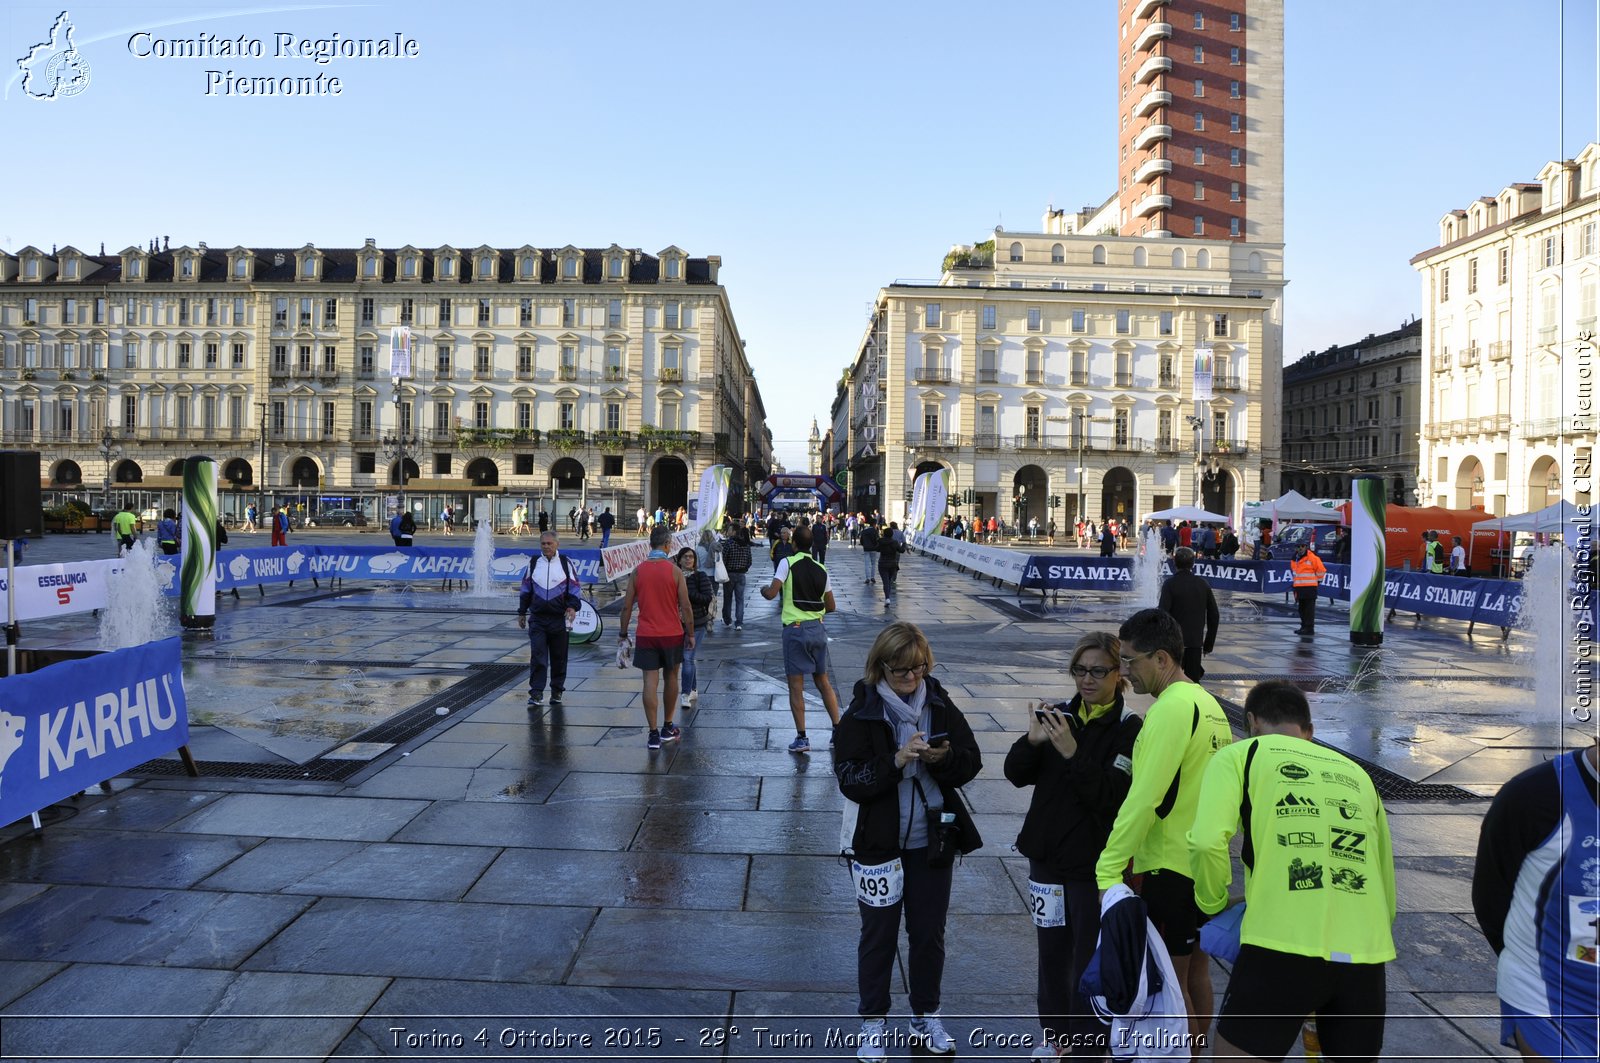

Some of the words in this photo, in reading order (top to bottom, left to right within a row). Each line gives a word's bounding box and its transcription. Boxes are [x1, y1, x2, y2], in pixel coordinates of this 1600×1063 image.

[253, 557, 284, 578] KARHU
[308, 555, 360, 573] ARHU
[1048, 565, 1132, 581] STAMPA
[1193, 563, 1258, 582] TAMPA
[38, 572, 87, 588] ESSELUNGA
[1400, 583, 1421, 600] LA
[1424, 585, 1477, 607] STAMPA
[1480, 593, 1504, 611] LA
[39, 673, 177, 780] KARHU
[862, 865, 892, 876] KARHU
[860, 877, 889, 897] 493
[1029, 884, 1052, 895] ARHU
[1295, 878, 1315, 889] CLUB
